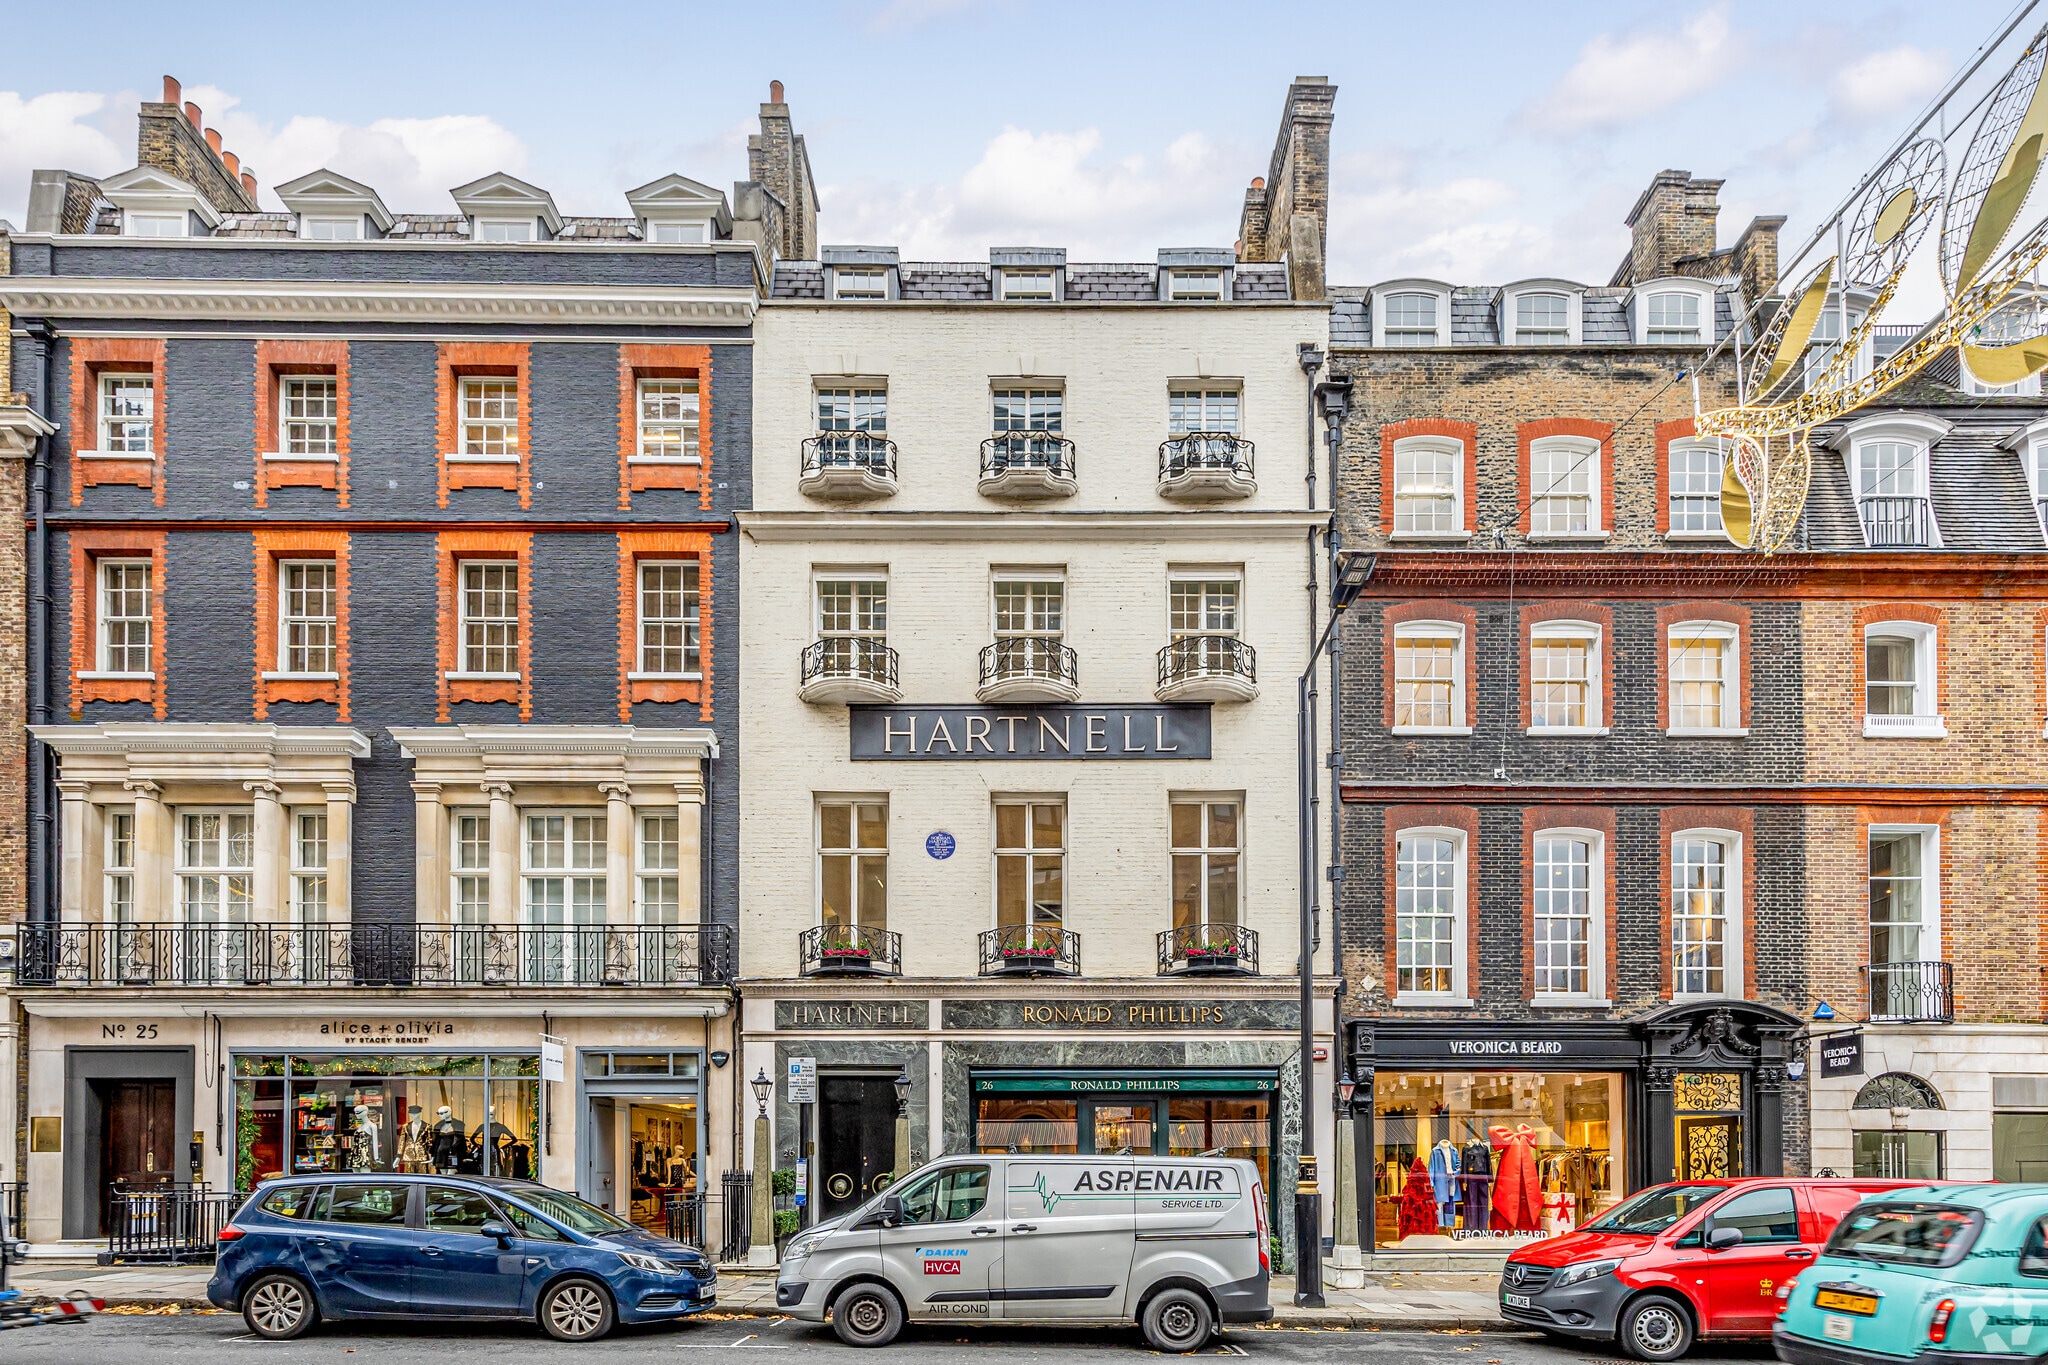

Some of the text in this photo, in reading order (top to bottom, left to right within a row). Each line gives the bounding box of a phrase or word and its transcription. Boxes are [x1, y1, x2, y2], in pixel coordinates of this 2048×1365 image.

[884, 715, 1179, 753] HARTNELL
[792, 1005, 915, 1024] HARTNELL
[1023, 1006, 1223, 1023] RONALD PHILLIPS
[136, 1024, 159, 1039] 25
[320, 1021, 371, 1034] alice
[395, 1021, 454, 1034] olivia
[1449, 1041, 1562, 1054] VERONICA BEARD
[1823, 1046, 1857, 1058] VERONICA
[1830, 1057, 1850, 1067] BEARD
[982, 1080, 994, 1090] 26
[1071, 1080, 1180, 1090] RONALD PHILLIPS
[1257, 1080, 1269, 1089] 26
[783, 1148, 795, 1157] 26
[1073, 1170, 1225, 1191] ASPENAIR
[1162, 1200, 1224, 1208] SERVICE LTD.
[1452, 1230, 1549, 1240] VERONICA BEARD
[925, 1262, 959, 1272] HVCA
[929, 1304, 988, 1313] AIR COND
